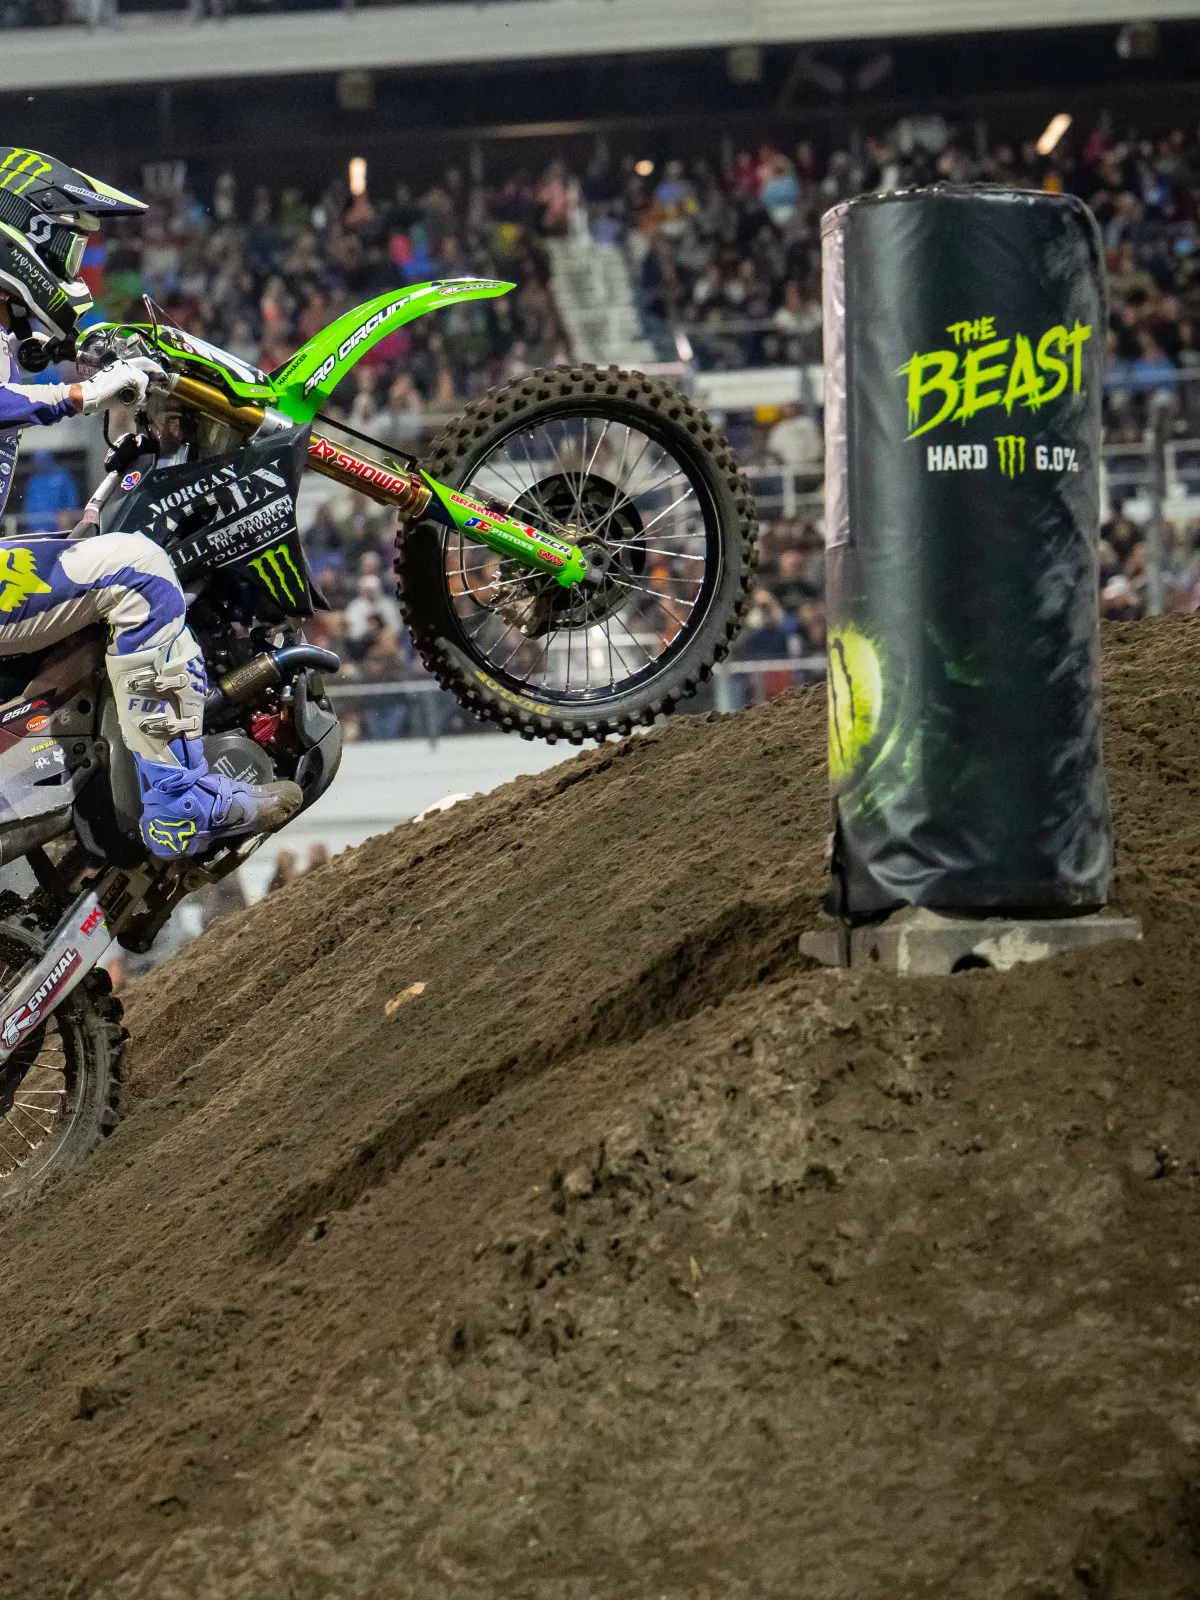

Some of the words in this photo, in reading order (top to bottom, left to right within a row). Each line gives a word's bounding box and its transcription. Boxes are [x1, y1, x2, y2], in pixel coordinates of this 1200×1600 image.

[11, 249, 55, 296] MONSTER
[303, 353, 336, 400] PRO
[338, 295, 410, 361] CIRCUIT
[946, 316, 997, 345] THE
[277, 353, 308, 386] HAMMAKER
[895, 319, 1091, 441] BEAST
[335, 454, 407, 495] SHOWA
[927, 446, 988, 472] HARD
[1035, 446, 1079, 473] 6.0%
[148, 463, 238, 519] MORGAN
[449, 493, 508, 525] BRAKING
[203, 541, 250, 567] TOUR
[254, 520, 289, 543] 2026
[465, 516, 492, 534] JE
[491, 526, 534, 551] PISTONS
[537, 549, 564, 566] GUTS
[128, 698, 169, 714] FOX
[474, 669, 551, 715] DUNLOP
[28, 721, 41, 729] Twin
[79, 906, 103, 936] RK
[1, 948, 80, 1048] RENTHAL
